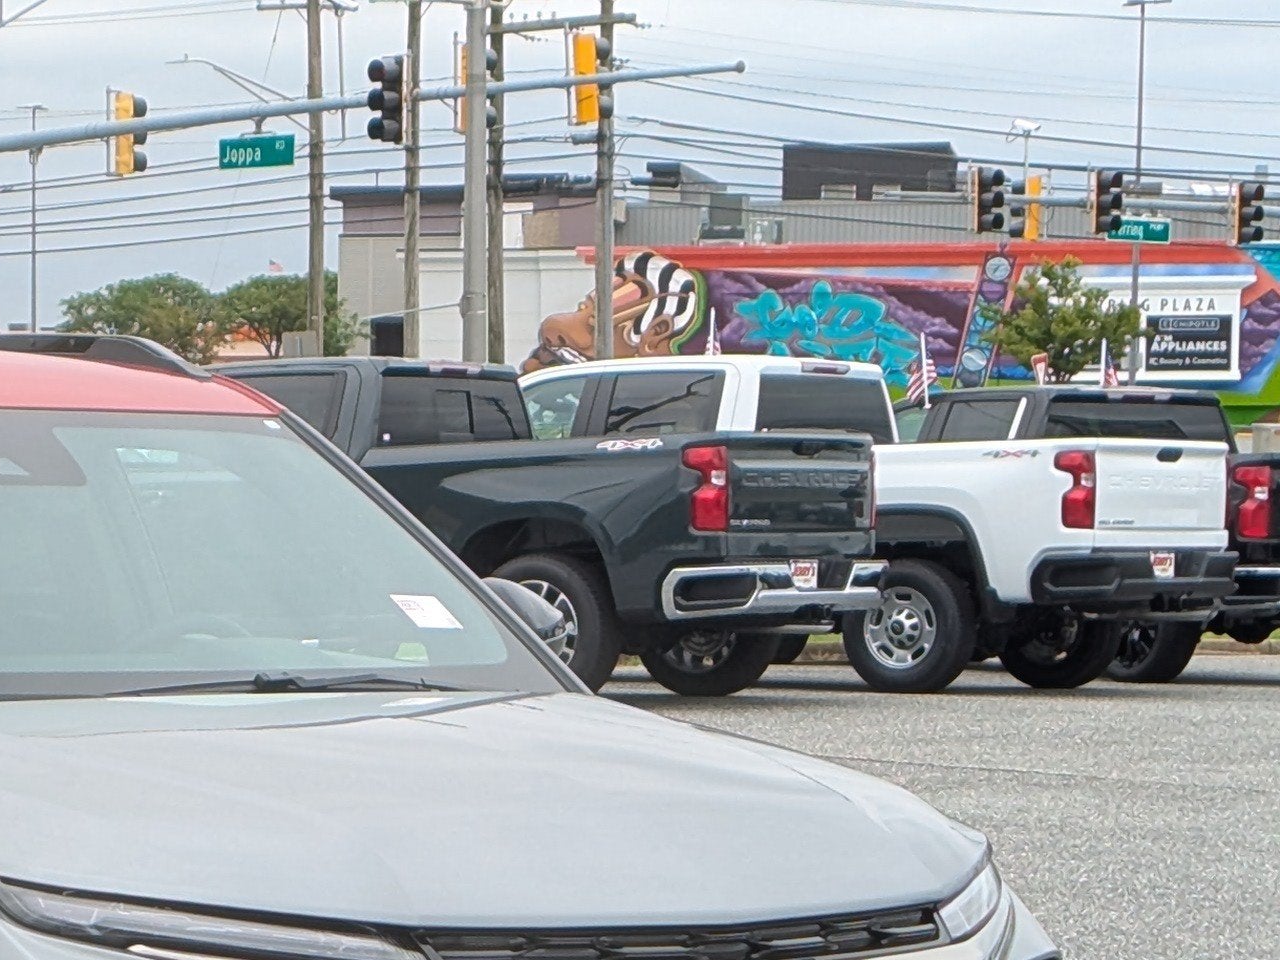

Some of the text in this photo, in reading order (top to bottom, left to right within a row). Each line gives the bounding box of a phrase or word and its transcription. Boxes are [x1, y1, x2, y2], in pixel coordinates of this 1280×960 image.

[223, 145, 261, 165] Joppa
[1160, 297, 1216, 312] PLAZA
[1150, 340, 1227, 352] APPLIANCES
